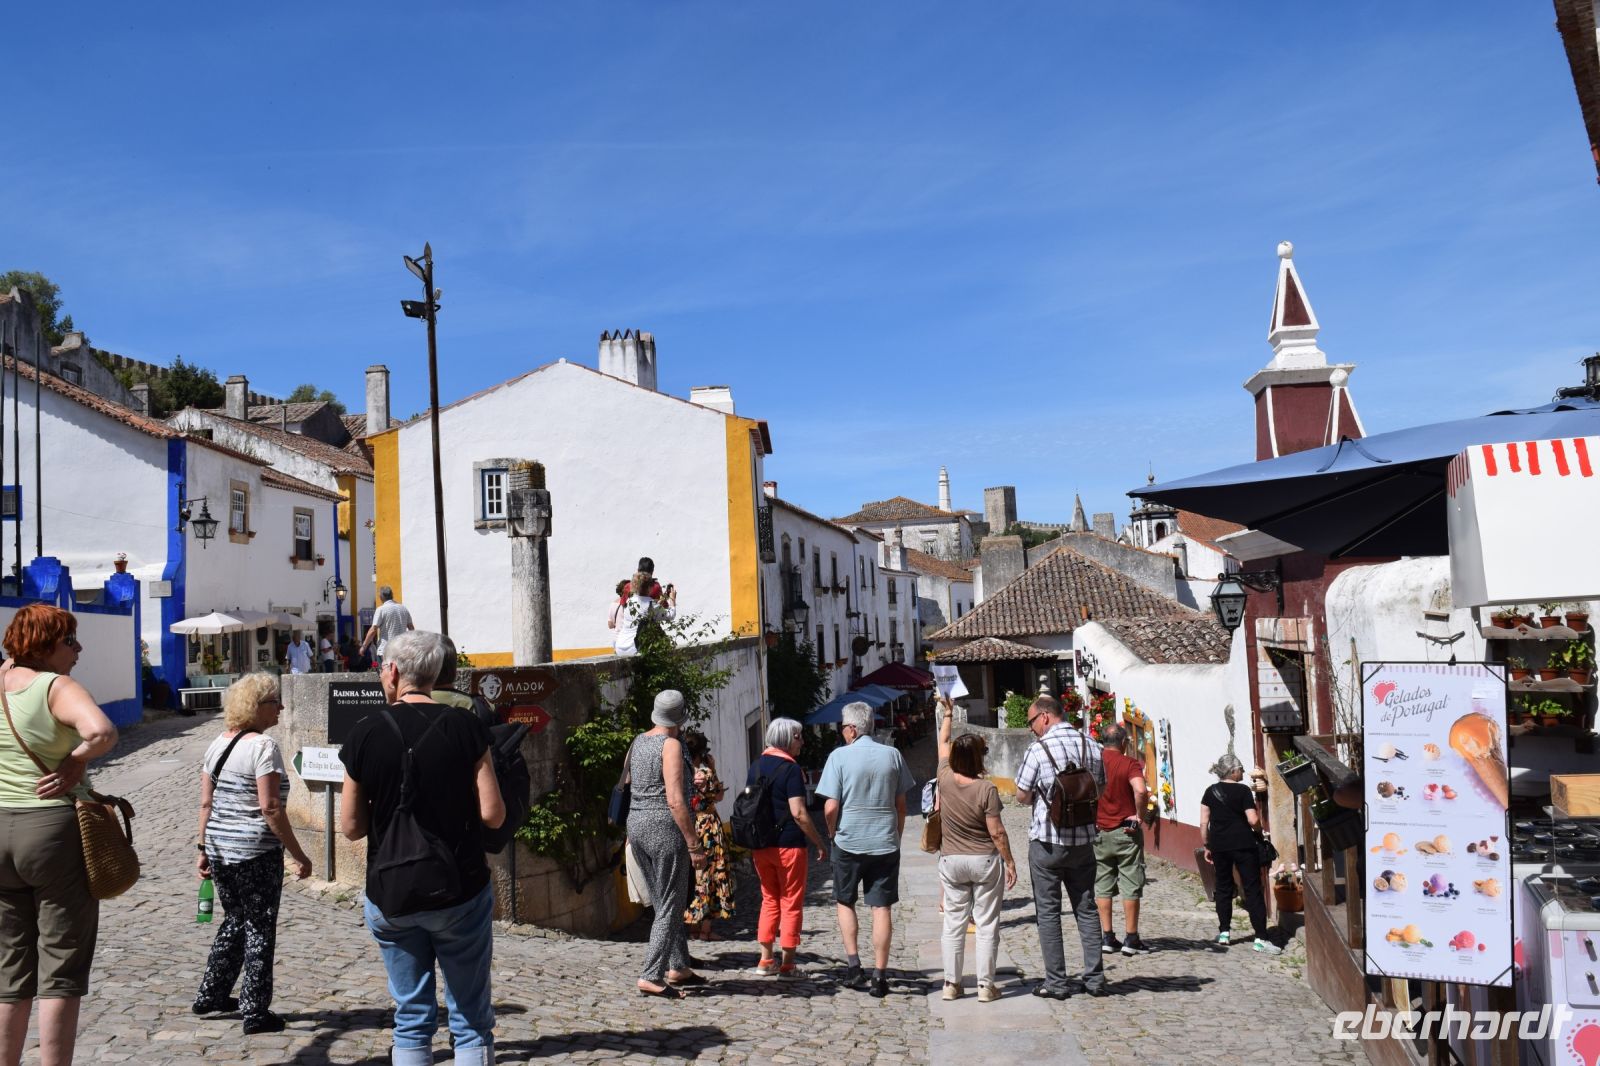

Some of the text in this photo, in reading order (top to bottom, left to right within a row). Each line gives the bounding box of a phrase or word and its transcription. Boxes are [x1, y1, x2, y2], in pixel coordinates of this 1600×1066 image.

[1384, 685, 1432, 707] Gelados
[1380, 694, 1448, 727] de Portugal
